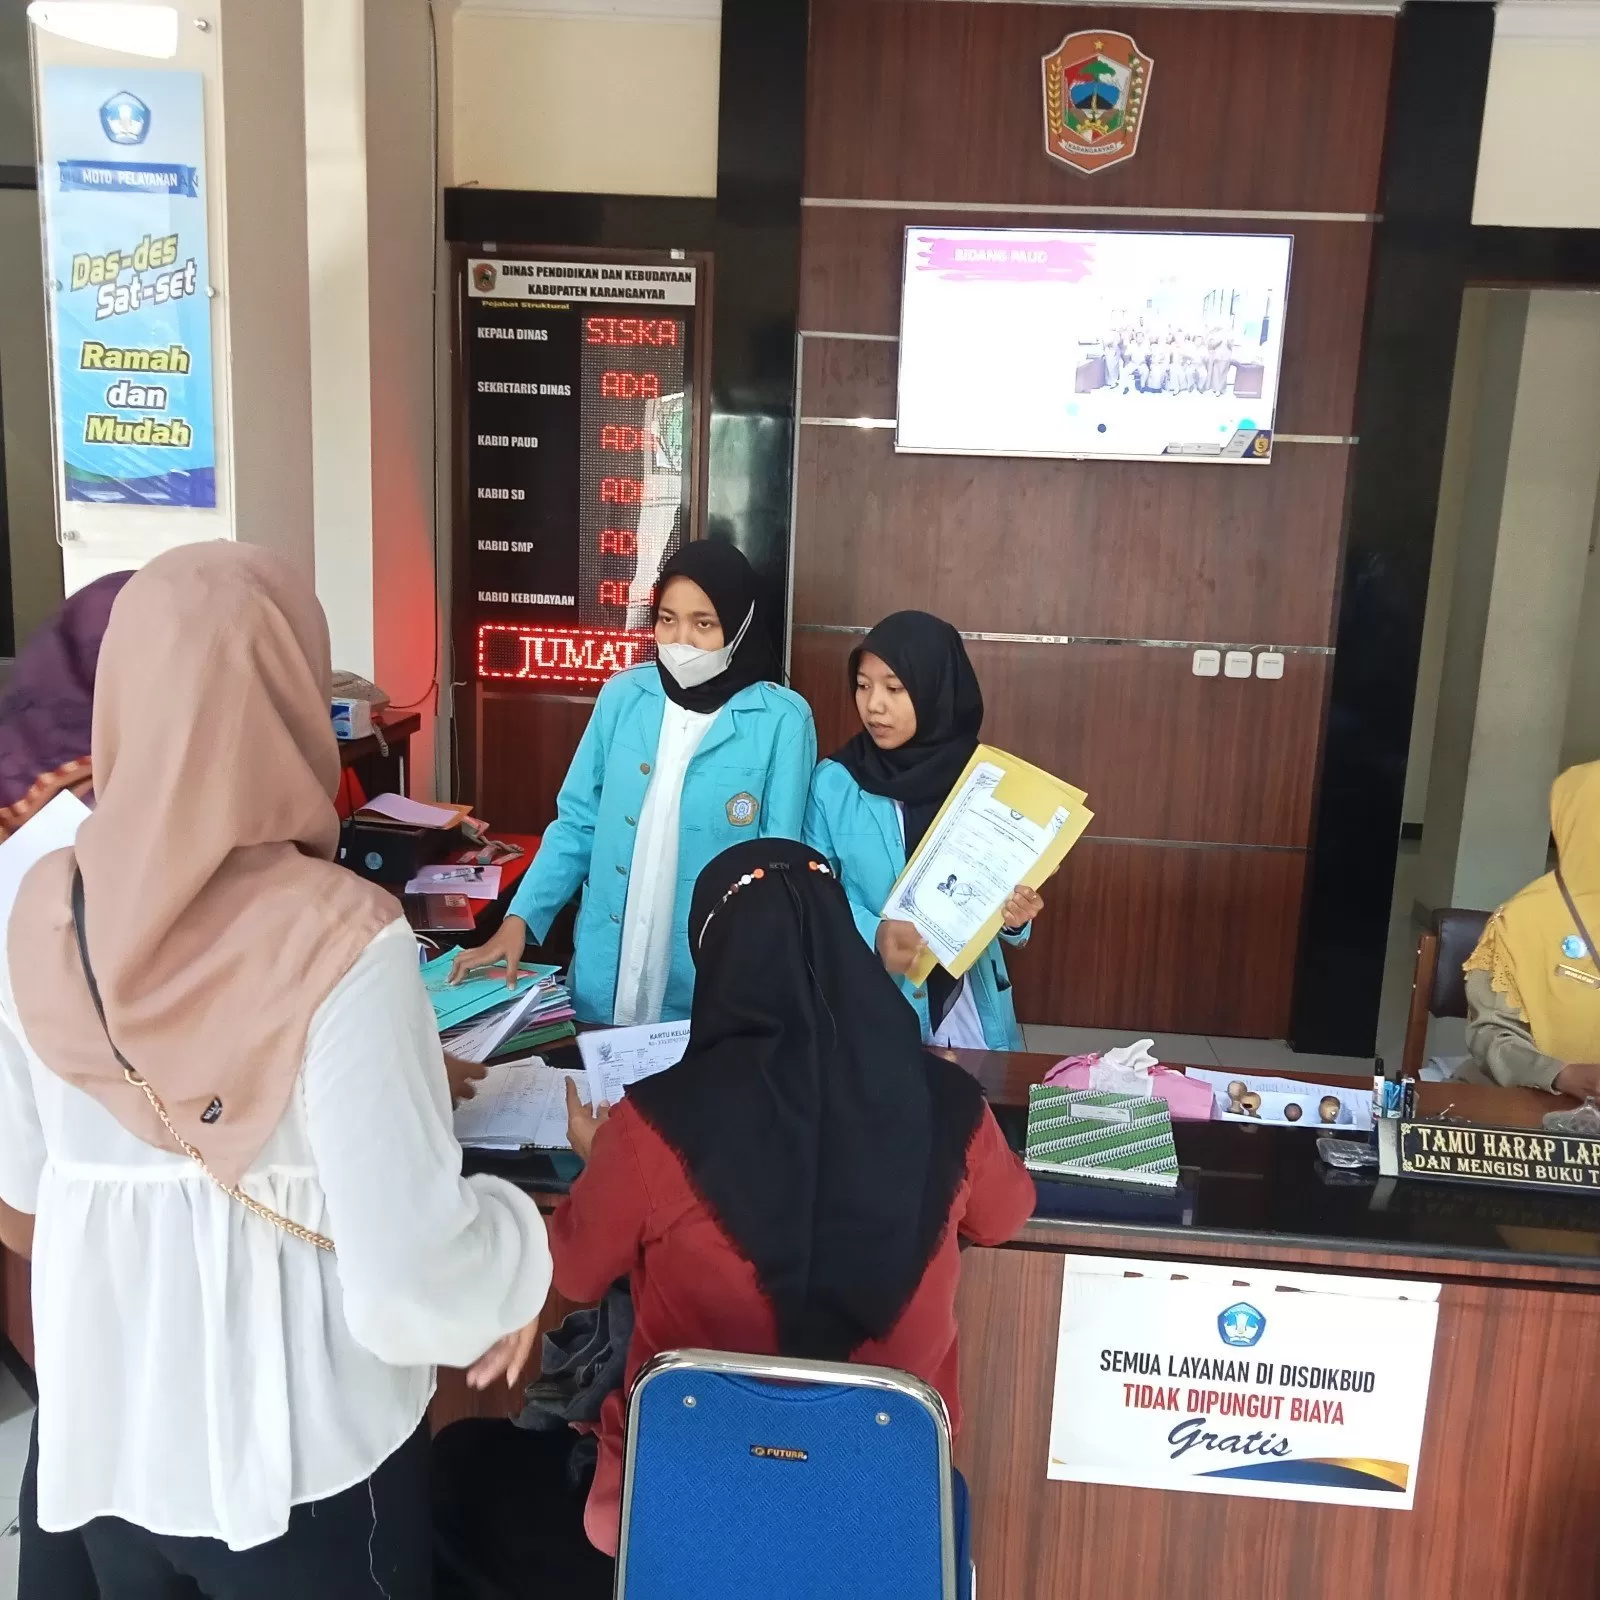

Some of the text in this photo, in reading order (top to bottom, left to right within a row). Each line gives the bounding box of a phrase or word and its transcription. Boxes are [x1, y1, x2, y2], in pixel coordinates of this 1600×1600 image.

[83, 168, 177, 187] MOTO PELAYANAN
[70, 233, 178, 292] Das-des
[502, 265, 691, 282] DINAS PENDIDIKAN DAN KEBUDAYAAN
[95, 257, 197, 321] Sat-set
[528, 284, 665, 299] KABUPATEN KARANGANYAR
[482, 300, 569, 310] Pejabat Struktural
[477, 327, 548, 341] KEPALA DINAS
[586, 317, 677, 345] SISKA
[80, 341, 190, 374] Ramah
[106, 380, 167, 409] dan
[478, 381, 571, 396] SEKRETARIS DINAS
[601, 372, 659, 399] ADA
[85, 415, 192, 447] Mudah
[478, 434, 538, 448] KABID PAUD
[478, 487, 525, 500] KABID SD
[478, 539, 533, 553] KABID SMP
[478, 591, 575, 606] KABID KEBUDAYAAN
[519, 636, 639, 677] JUMAT
[649, 1031, 670, 1040] KARTU
[1418, 1128, 1600, 1166] TAMU HARAP LAP
[1415, 1154, 1600, 1184] DAN MENGISI BUKU T
[1100, 1349, 1375, 1393] SEMUA LAYANAN DI DISDIKBUD
[1124, 1383, 1344, 1425] TIDAK DIPUNGUT BIAYA
[1168, 1417, 1293, 1459] Gratis
